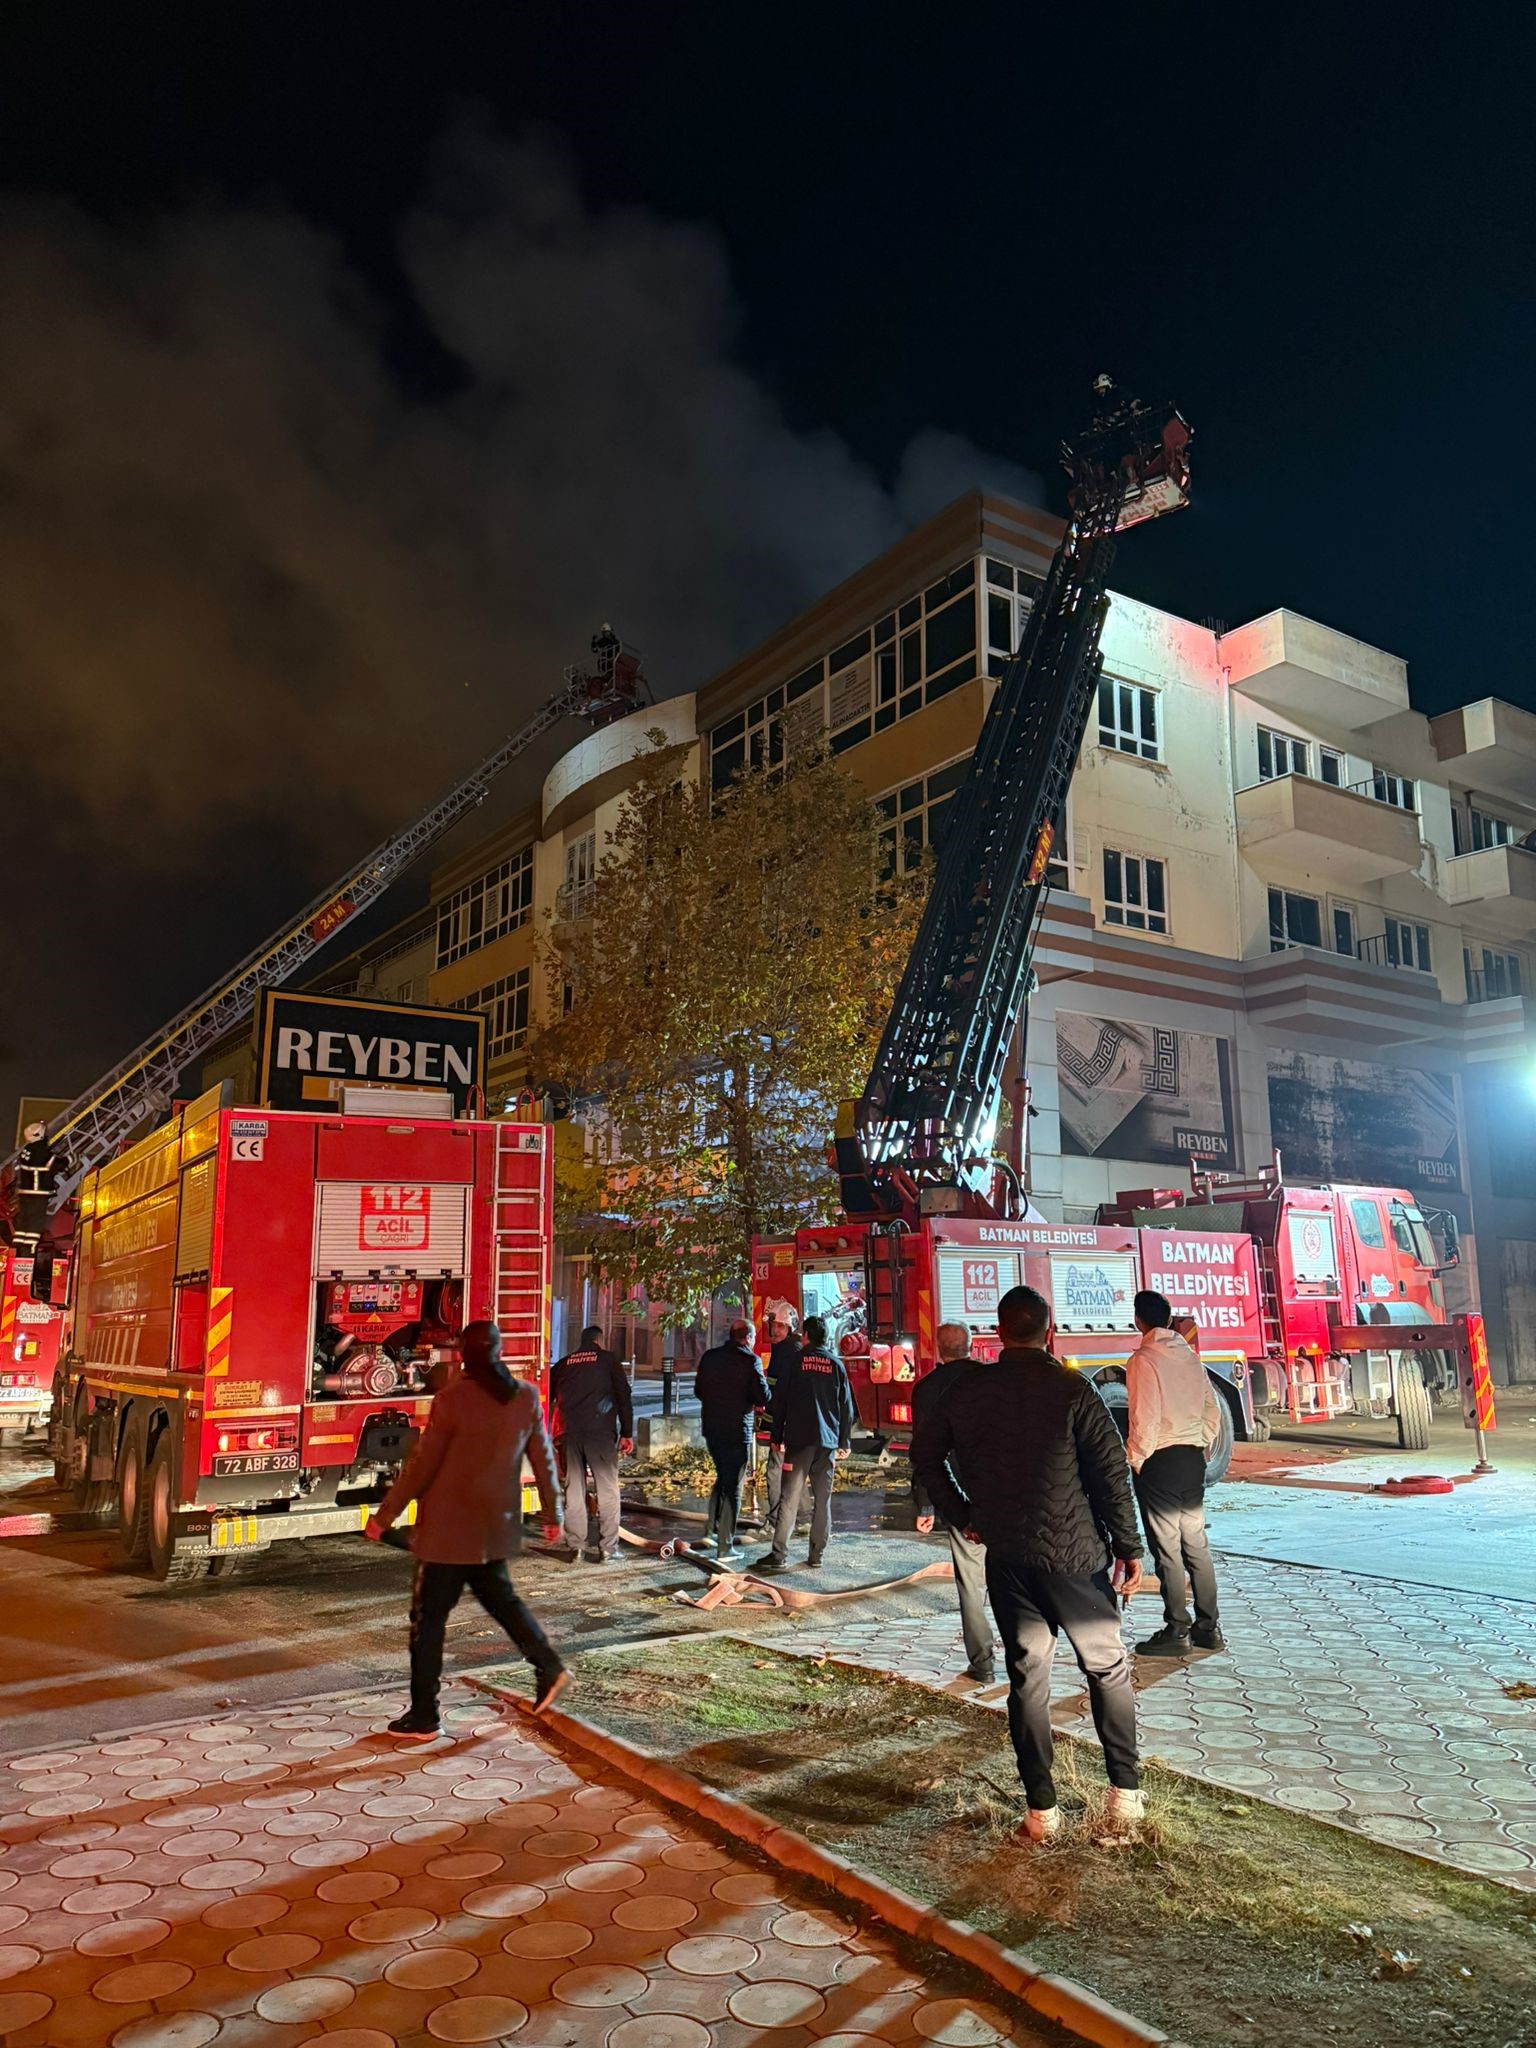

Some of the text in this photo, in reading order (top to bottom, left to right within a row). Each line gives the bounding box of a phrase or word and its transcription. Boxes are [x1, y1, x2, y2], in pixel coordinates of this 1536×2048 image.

[1041, 831, 1051, 853] M
[320, 904, 346, 930] 24 M
[276, 1027, 472, 1085] REYBEN
[1177, 1132, 1228, 1153] REYBEN
[1418, 1160, 1457, 1177] REYBEN
[370, 1187, 424, 1210] 112
[376, 1217, 414, 1232] ACİL
[979, 1227, 1098, 1245] BATMAN BELEDİYESİ
[1161, 1241, 1235, 1264] BATMAN
[967, 1264, 995, 1285] 112
[1150, 1268, 1250, 1296] BELEDİYESİ
[973, 1290, 992, 1301] ACİL
[1065, 1288, 1115, 1306] BATMAN
[224, 1455, 297, 1473] 72 ABF 328
